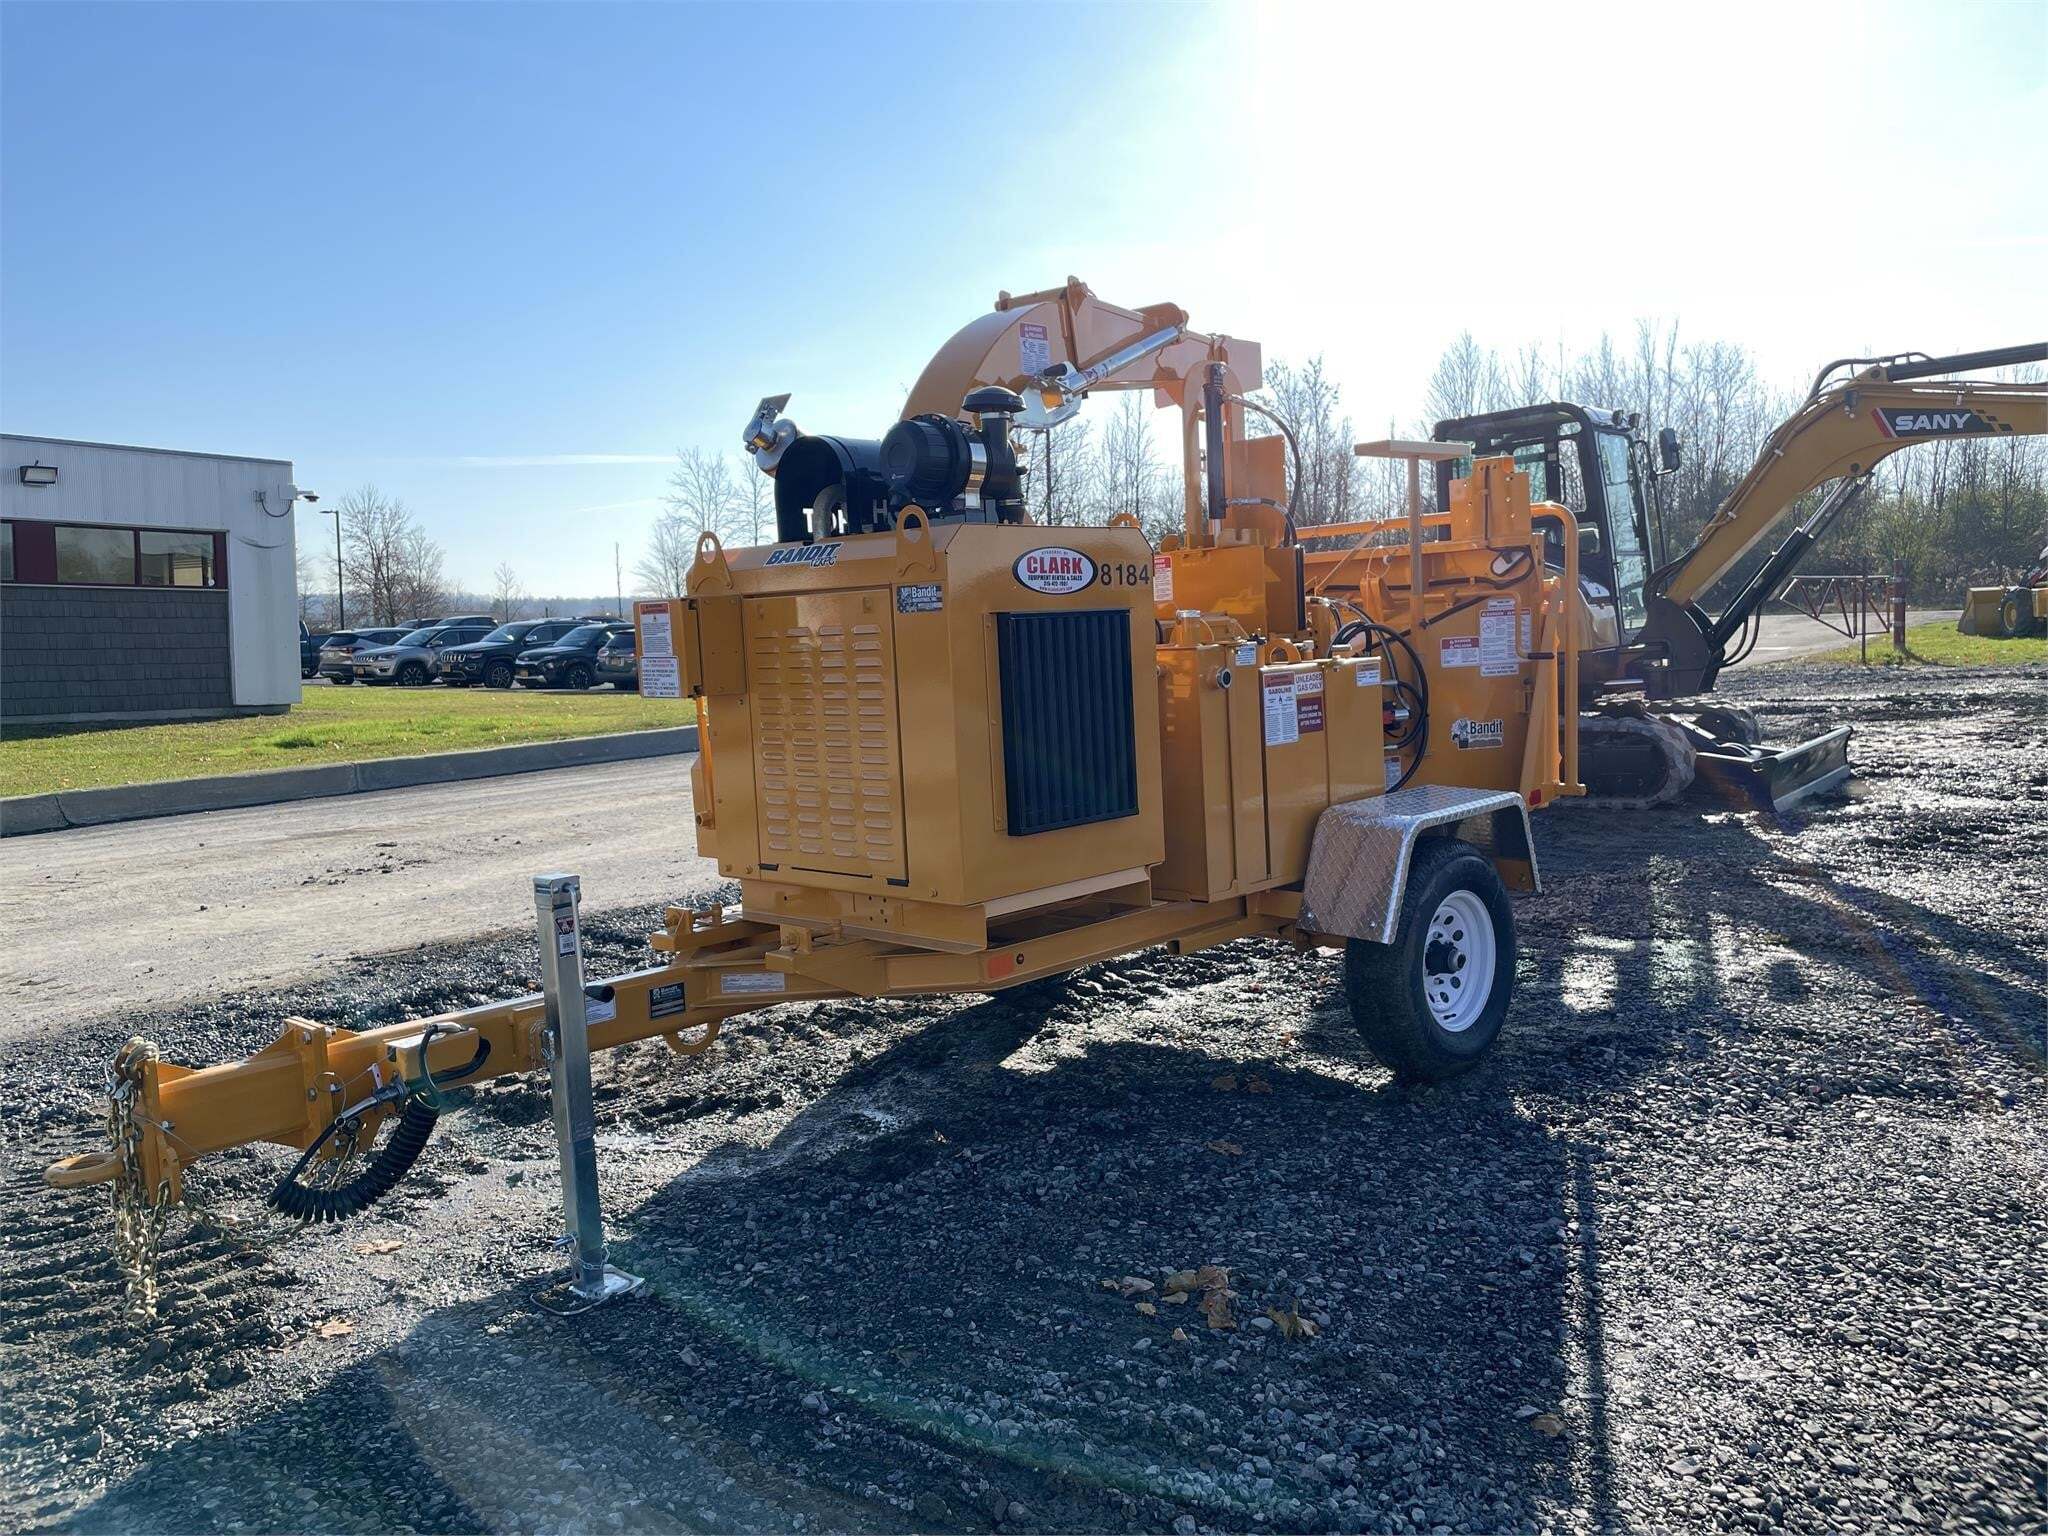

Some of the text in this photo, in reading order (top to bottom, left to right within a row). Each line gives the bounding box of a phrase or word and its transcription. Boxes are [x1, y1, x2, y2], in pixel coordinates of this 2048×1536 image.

[1895, 413, 1971, 431] SANY
[764, 543, 842, 565] BANDIT
[1026, 555, 1083, 575] CLARK
[1100, 563, 1150, 586] 8184
[911, 584, 937, 598] Bandit
[1295, 672, 1323, 684] UNLEADED
[1297, 681, 1322, 692] GAS ONLY
[1470, 719, 1503, 735] Bandit
